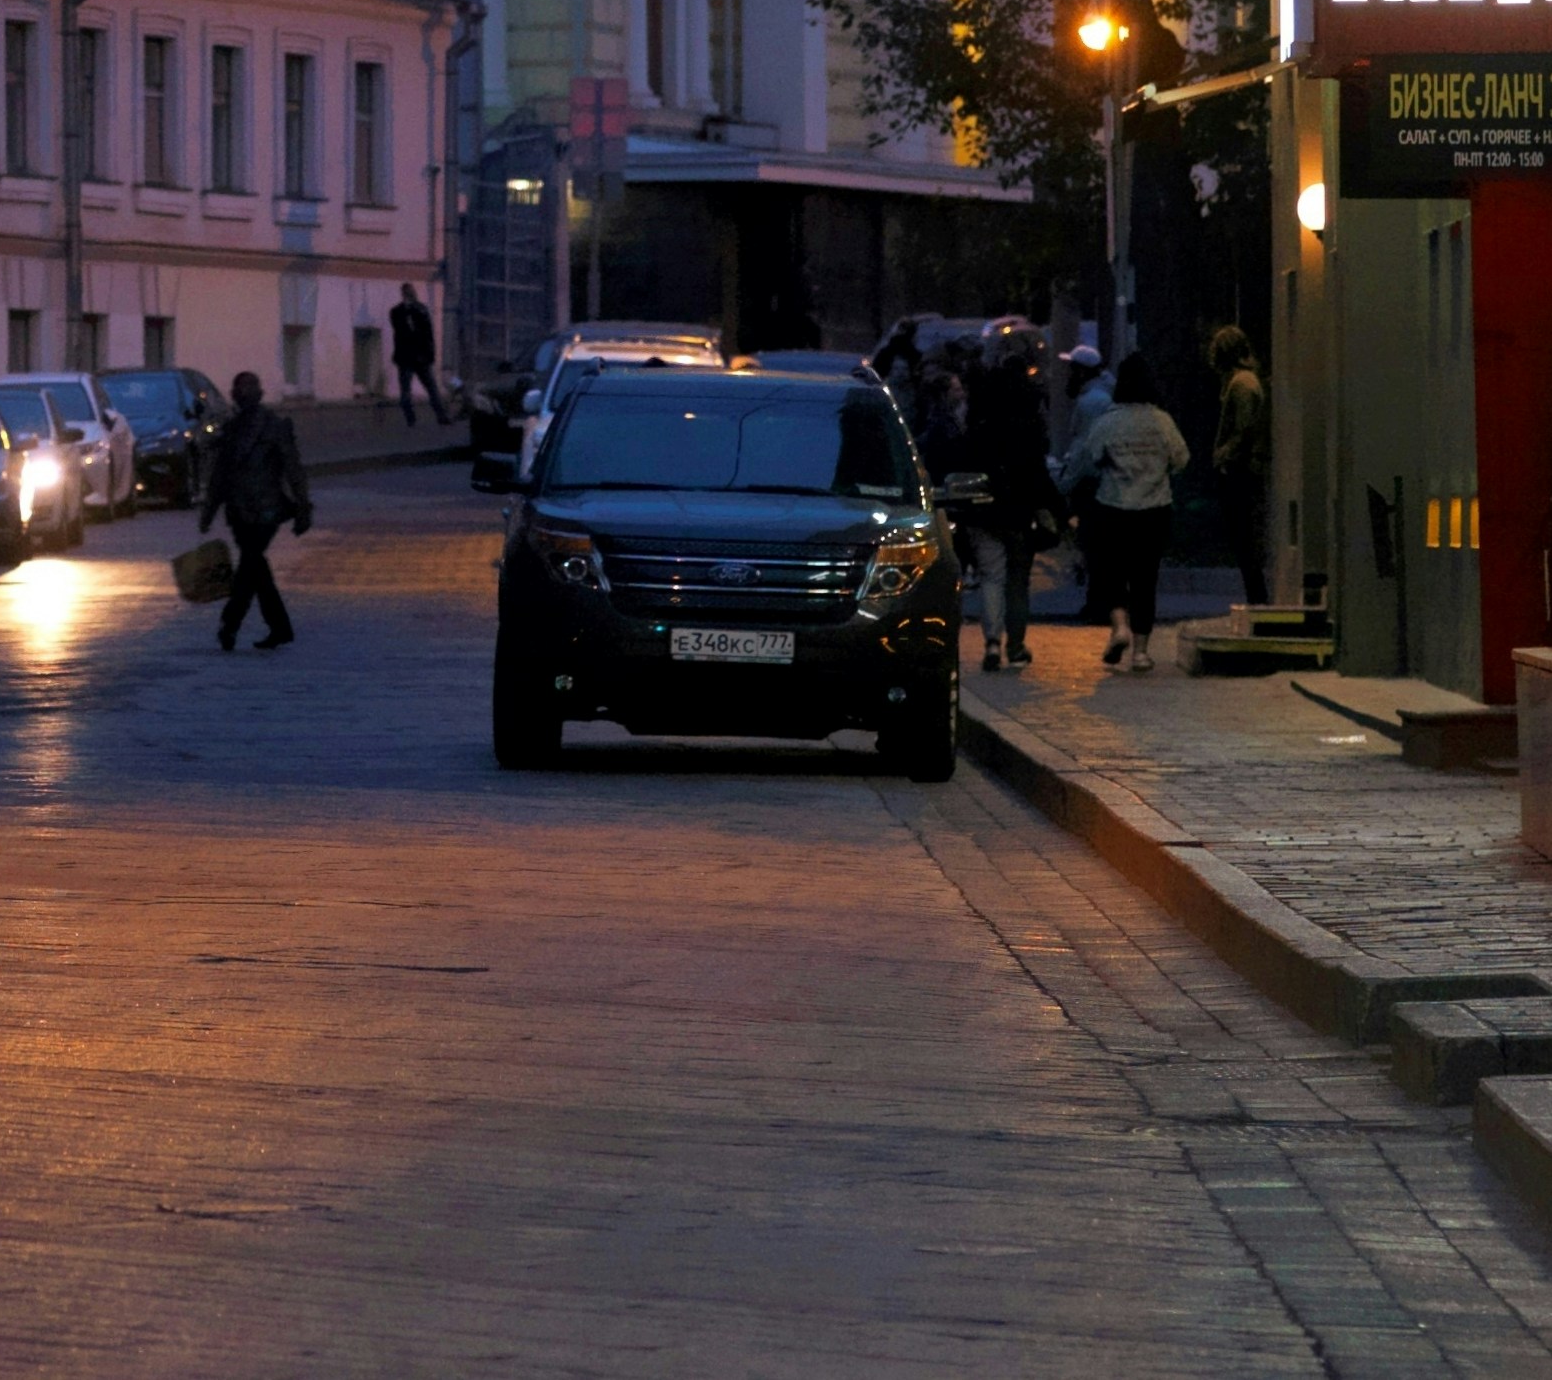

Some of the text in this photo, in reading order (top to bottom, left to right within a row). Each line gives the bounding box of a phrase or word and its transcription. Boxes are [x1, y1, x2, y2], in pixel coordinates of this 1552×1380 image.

[1389, 72, 1544, 120] БИЗНЕС-ЛАНЧ
[1398, 129, 1436, 145] САЛАТ
[1447, 129, 1472, 145] СУП
[1482, 129, 1531, 145] ГОРЯЧЕЕ
[1453, 151, 1484, 167] ПН-ПТ
[1486, 151, 1512, 167] 12:00
[1519, 151, 1544, 167] 15:00
[759, 633, 789, 649] 777
